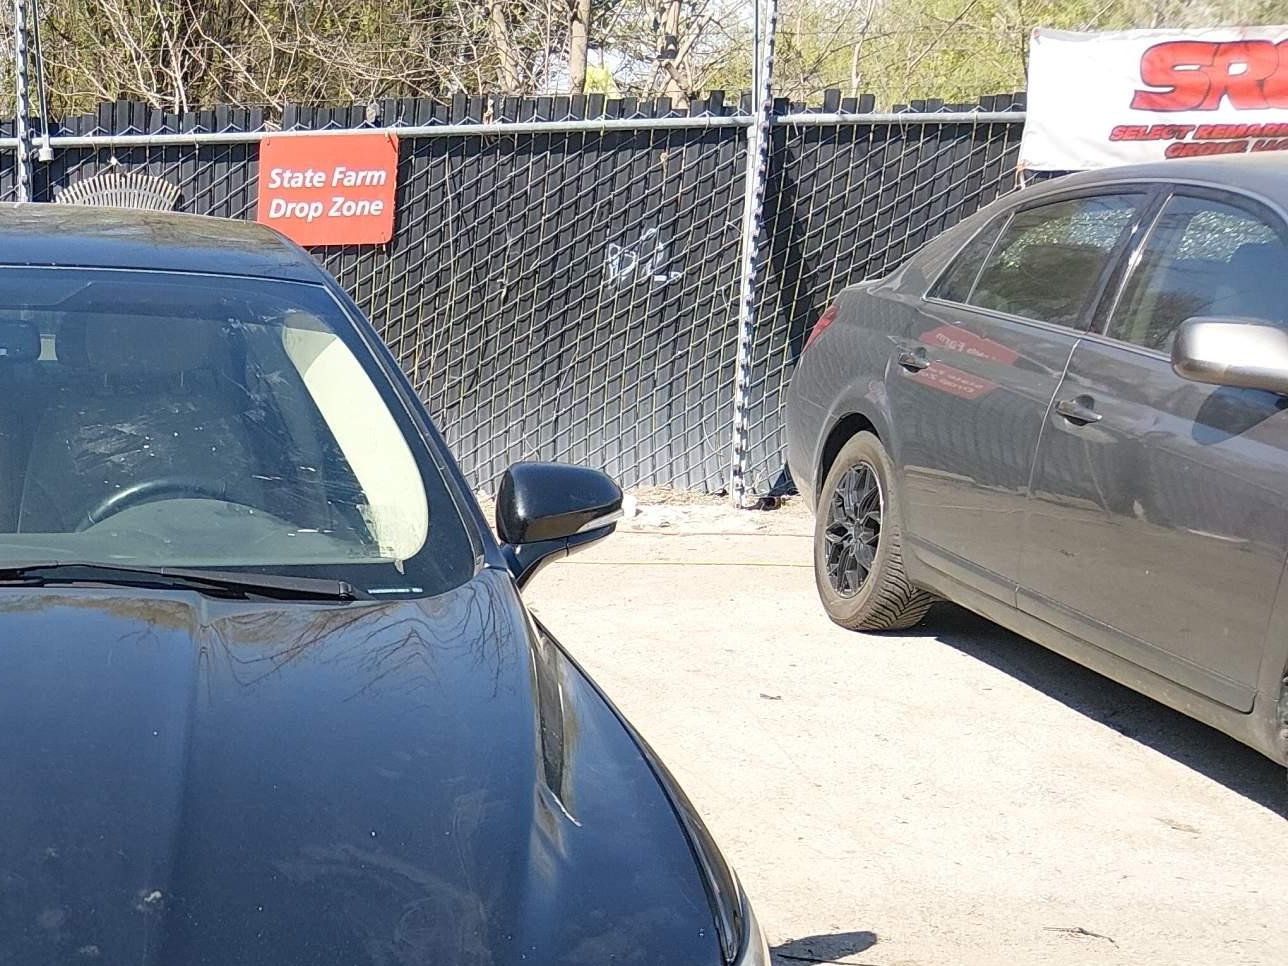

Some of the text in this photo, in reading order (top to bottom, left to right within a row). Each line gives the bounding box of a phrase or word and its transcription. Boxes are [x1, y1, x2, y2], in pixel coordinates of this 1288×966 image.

[1110, 124, 1195, 141] SELECT
[268, 166, 386, 189] State Farm
[268, 196, 384, 223] Drop Zone
